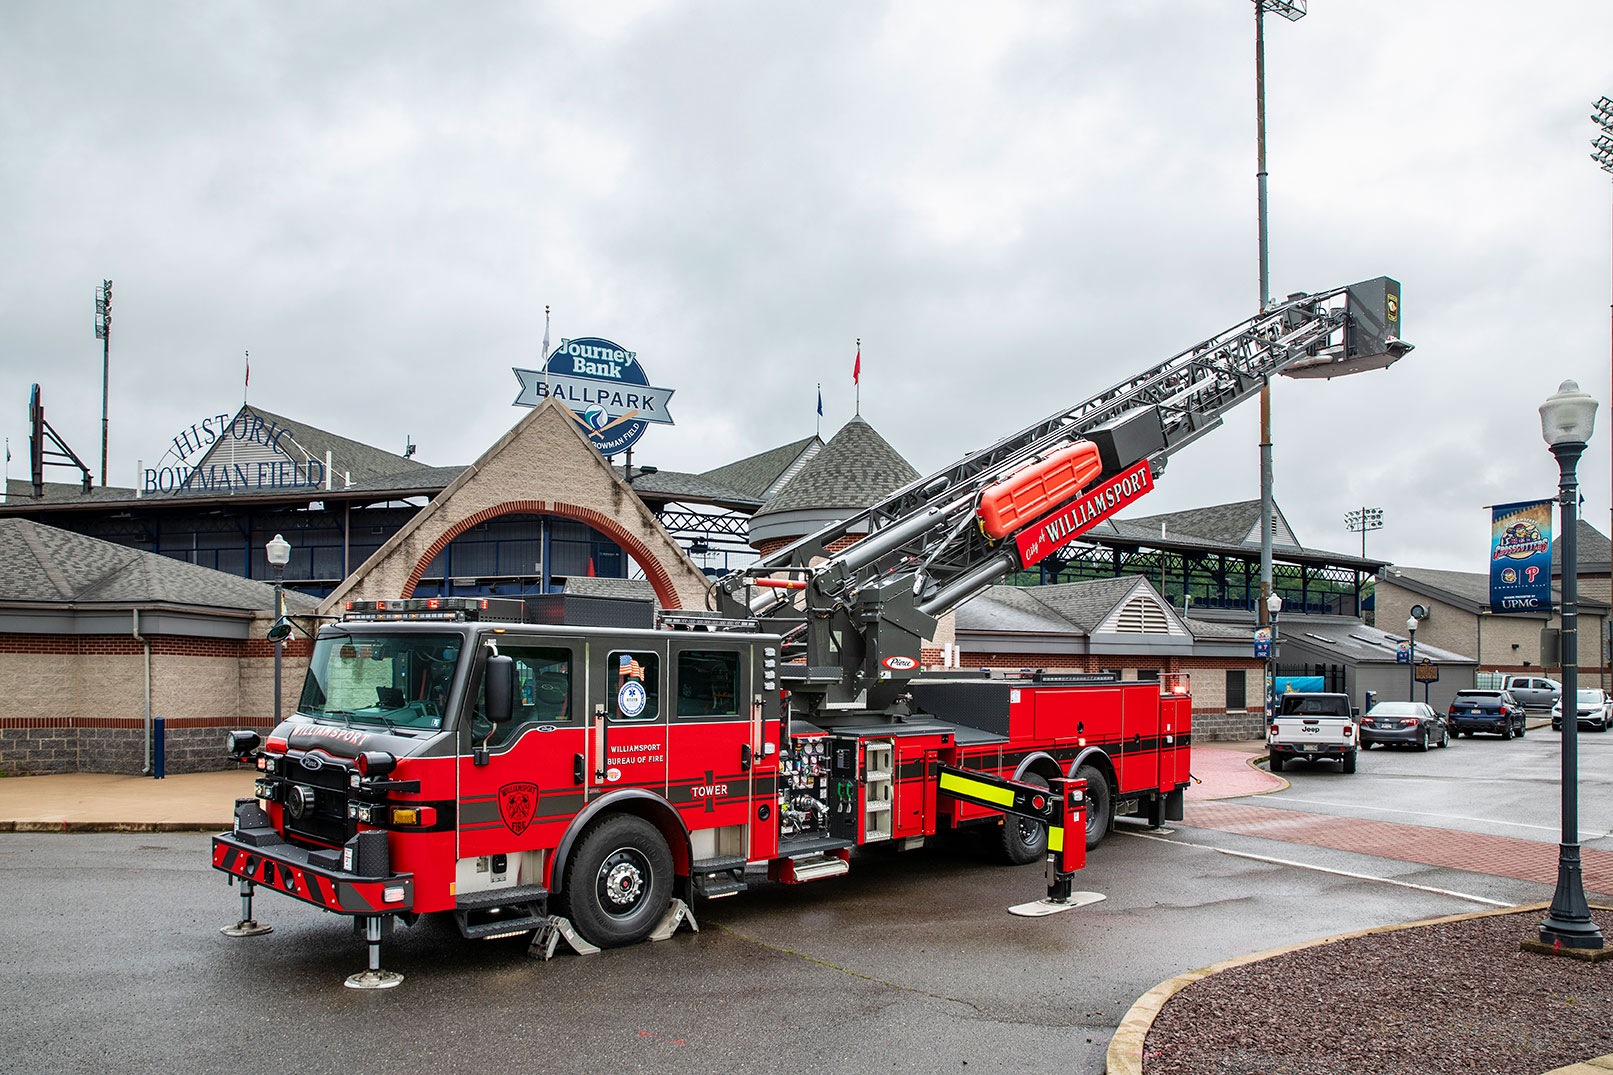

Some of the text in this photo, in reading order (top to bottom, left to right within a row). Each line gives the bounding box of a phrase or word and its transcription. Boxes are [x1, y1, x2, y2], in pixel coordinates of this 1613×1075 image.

[559, 338, 636, 367] Journey
[572, 357, 622, 378] Bank
[536, 381, 655, 412] BALLPARK
[172, 412, 293, 460] HISTORIC
[591, 422, 640, 450] BOWMAN FIELD
[144, 460, 324, 495] BOWMAN FIELD
[1025, 467, 1148, 561] City of WILLIAMSPORT
[1502, 598, 1538, 609] UPMC
[290, 726, 371, 746] WILLIAMSPORT
[610, 743, 661, 753] WILLIAMSPORT
[607, 755, 664, 766] BUREAU OF FIRE
[691, 784, 728, 798] TOWER
[511, 820, 527, 832] FIRE
